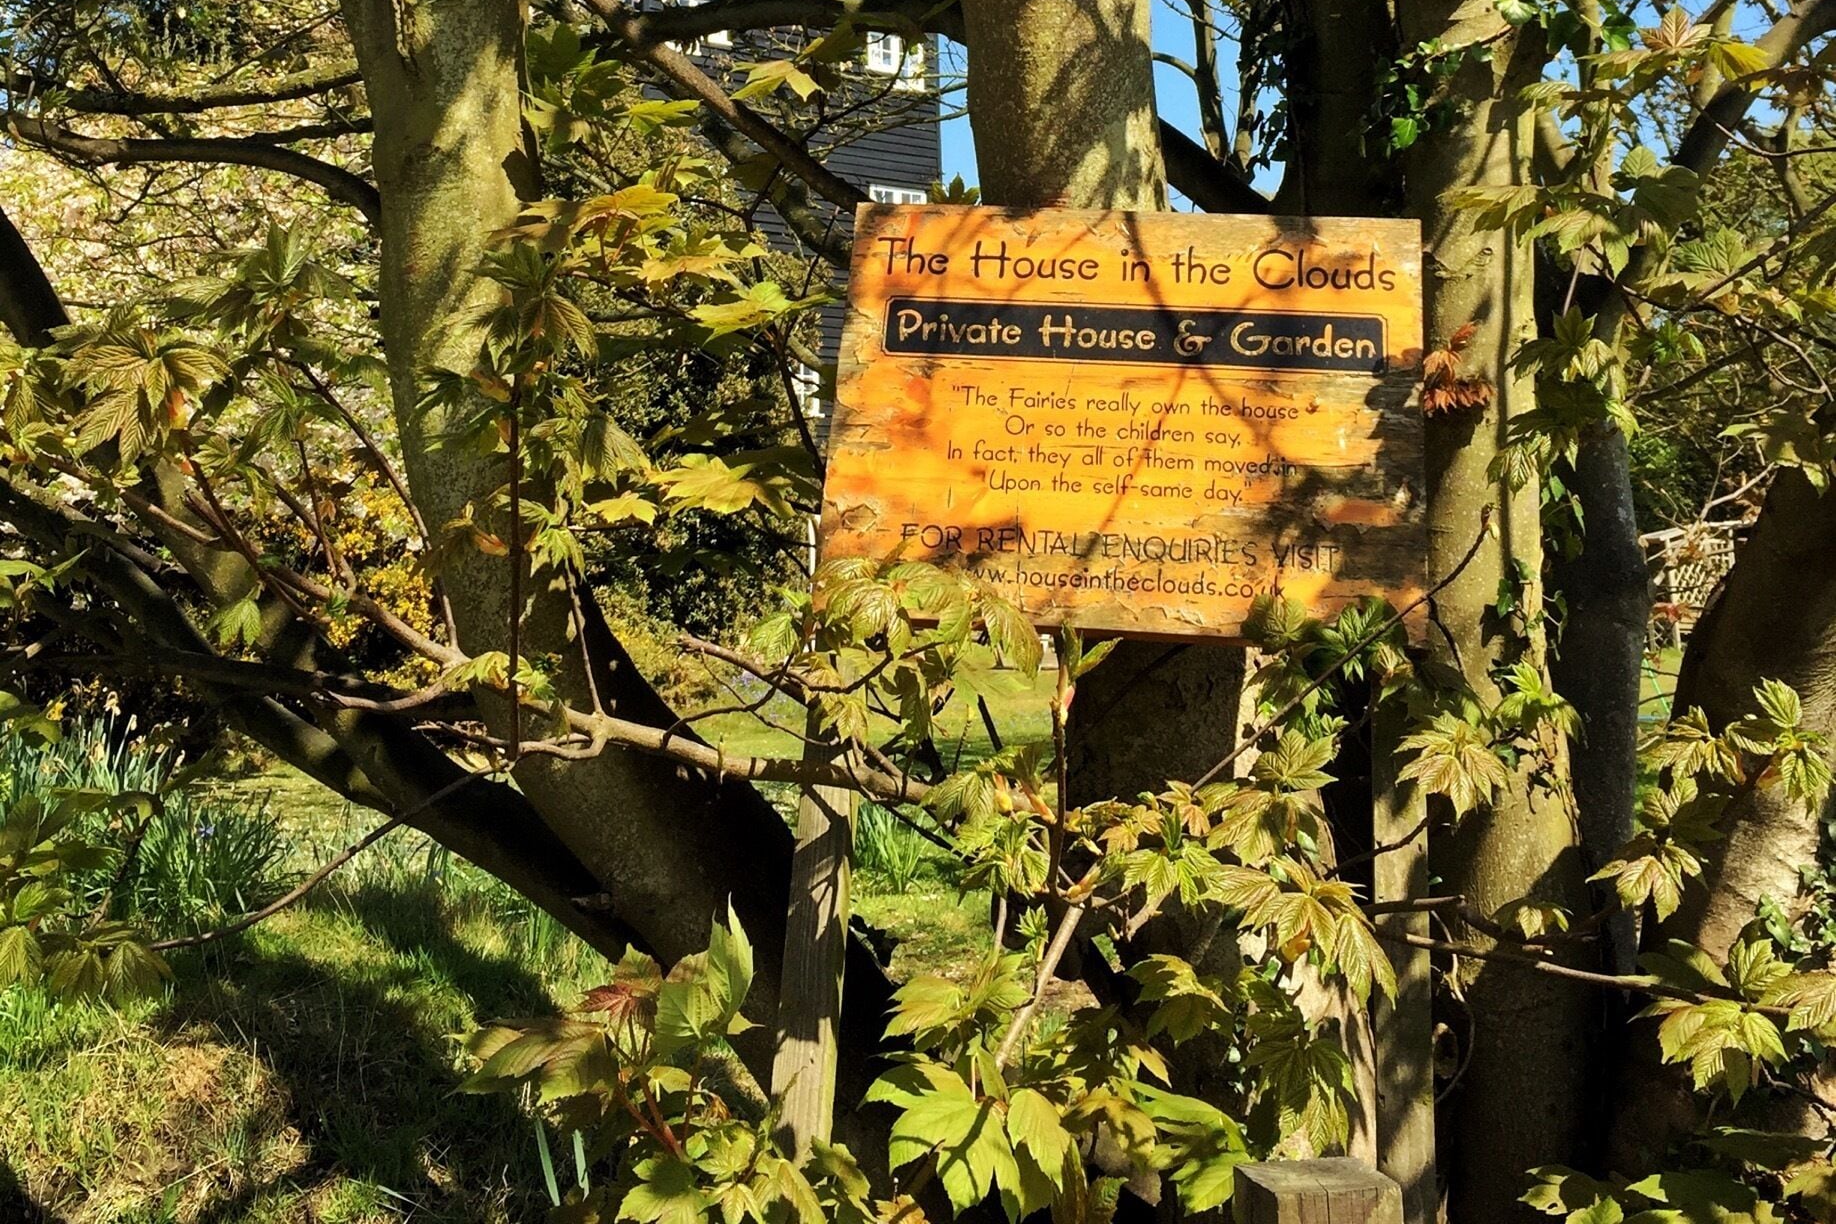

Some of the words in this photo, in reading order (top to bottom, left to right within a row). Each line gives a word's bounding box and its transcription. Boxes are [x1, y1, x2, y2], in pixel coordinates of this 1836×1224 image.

[878, 236, 949, 275] The
[970, 240, 1099, 280] House
[1120, 249, 1150, 283] in
[1171, 245, 1231, 285] the
[1253, 248, 1396, 291] Clouds
[897, 308, 1022, 345] Private
[1038, 314, 1156, 350] House
[1173, 319, 1212, 357] &
[1230, 321, 1376, 359] Garden
[952, 385, 998, 406] "The
[1009, 387, 1077, 410] Fairies
[1086, 391, 1141, 416] really
[1151, 401, 1190, 415] own
[1200, 395, 1232, 417] the
[1241, 397, 1299, 420] house
[1005, 414, 1035, 436] Or
[1044, 424, 1066, 437] so
[1076, 417, 1107, 439] the
[1116, 420, 1194, 442] children
[1205, 430, 1241, 448] say,
[947, 440, 963, 461] In
[973, 439, 1018, 463] fact,
[1028, 442, 1072, 469] they
[1082, 445, 1103, 466] all
[1113, 446, 1139, 468] of
[1144, 449, 1194, 470] them
[1204, 453, 1272, 474] moved
[1280, 456, 1297, 476] in
[989, 469, 1041, 494] Upon
[1051, 471, 1082, 493] the
[1093, 473, 1193, 498] self-same
[1204, 479, 1252, 506] day."
[900, 523, 962, 550] FOR
[976, 526, 1084, 558] RENTAL
[1102, 532, 1257, 566] ENQUIRIES
[1271, 543, 1341, 572] VISIT
[970, 560, 1288, 604] ww.houseintheclouds.co.uk
